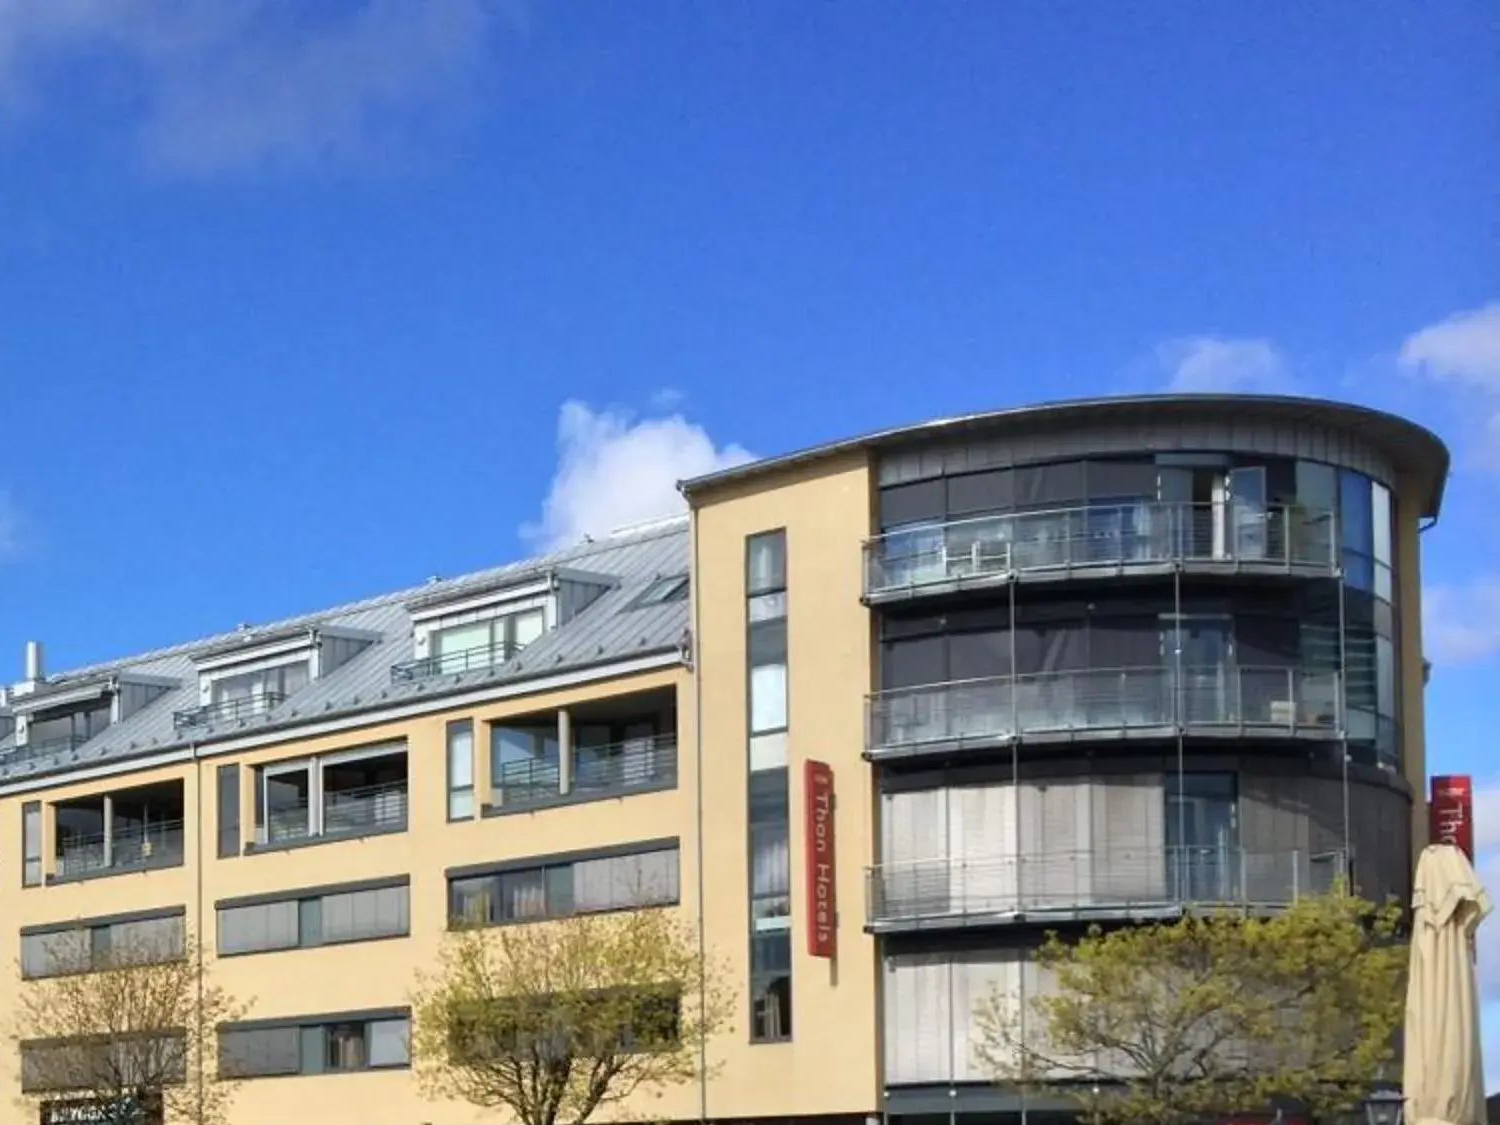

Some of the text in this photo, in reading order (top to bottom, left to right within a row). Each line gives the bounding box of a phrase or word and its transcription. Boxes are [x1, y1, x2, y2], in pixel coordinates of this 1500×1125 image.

[814, 791, 832, 942] Thon Hotels
[1438, 802, 1464, 843] Tho
